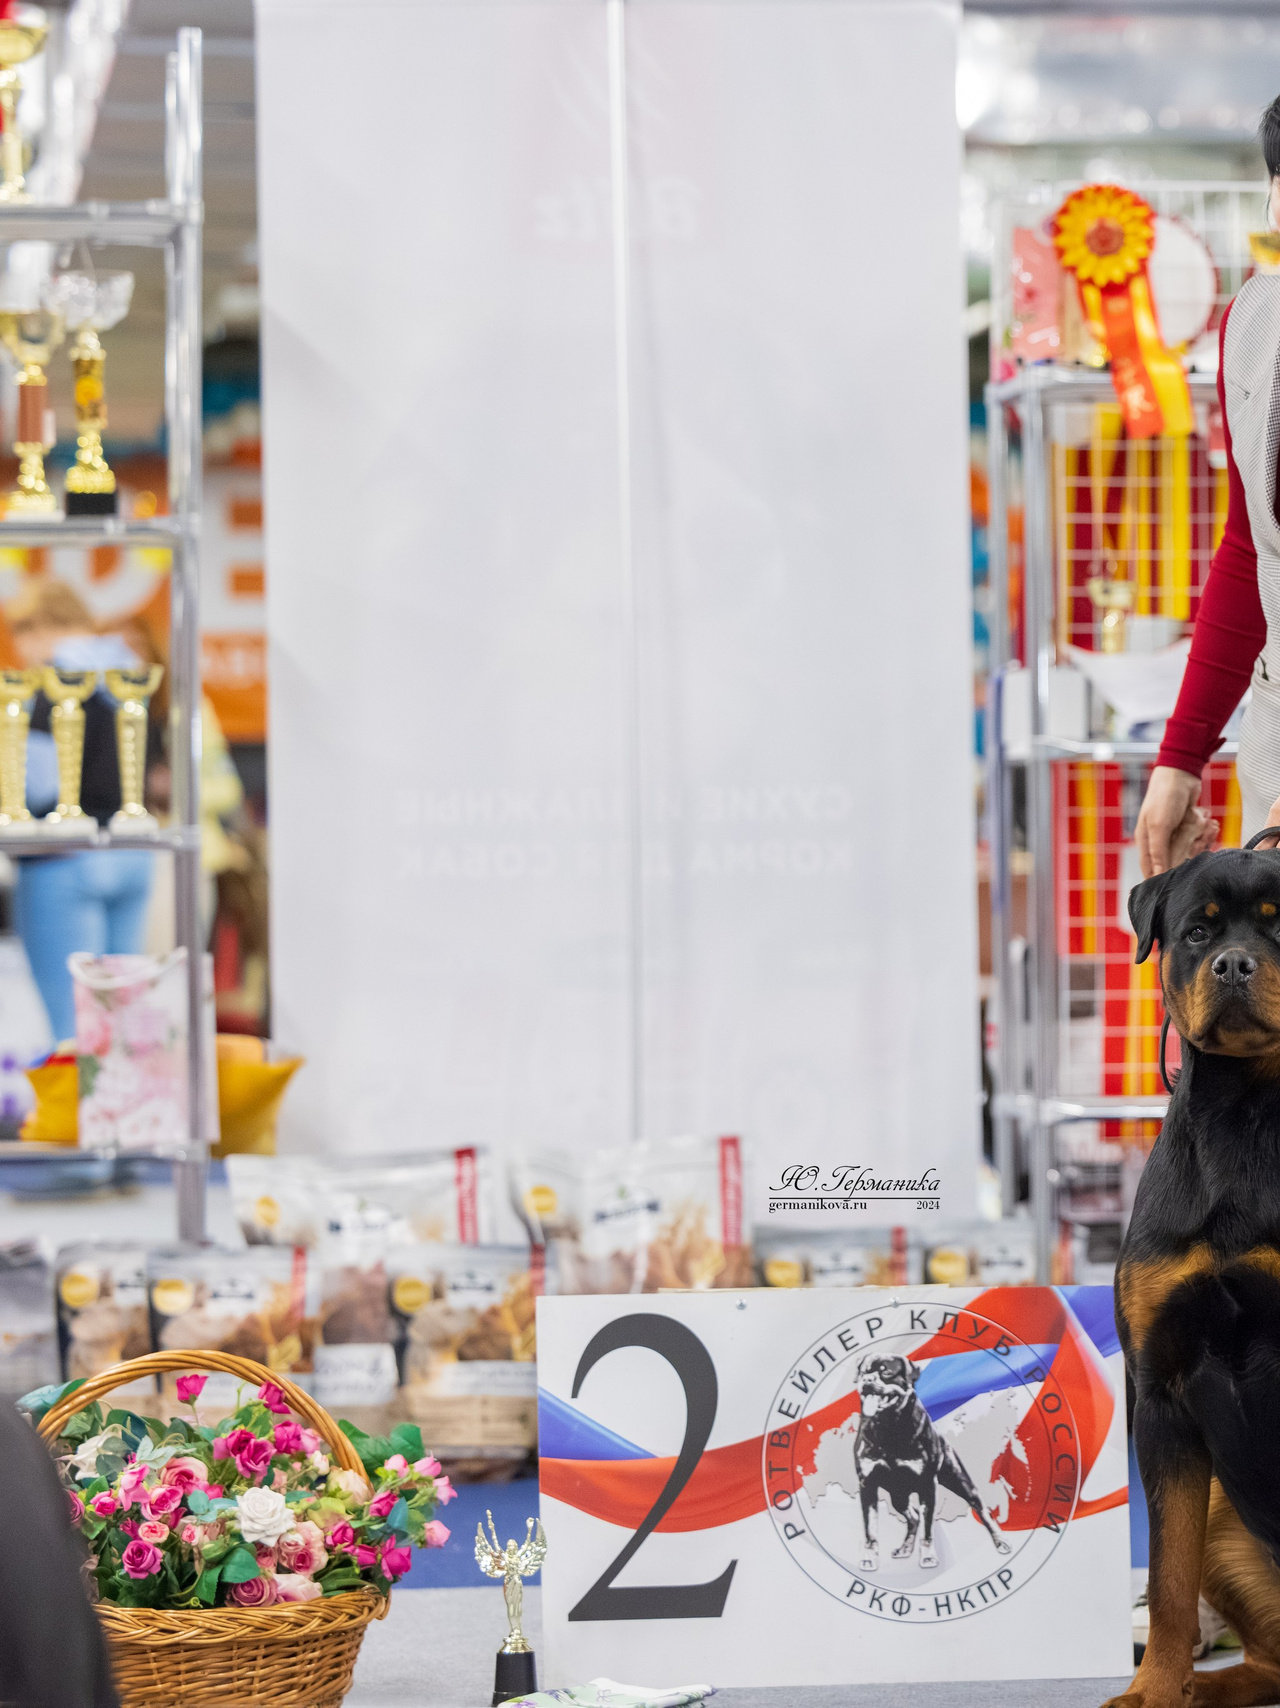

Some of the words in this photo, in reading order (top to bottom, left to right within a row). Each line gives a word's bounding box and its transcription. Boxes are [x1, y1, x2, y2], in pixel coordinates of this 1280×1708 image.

[568, 1312, 738, 1622] 2
[768, 1316, 884, 1540] РОТВЕЙЛЕР
[910, 1308, 1015, 1358] КЛУБ
[1024, 1366, 1076, 1535] РОССИИ
[846, 1567, 1013, 1618] РКФ-НКПР
